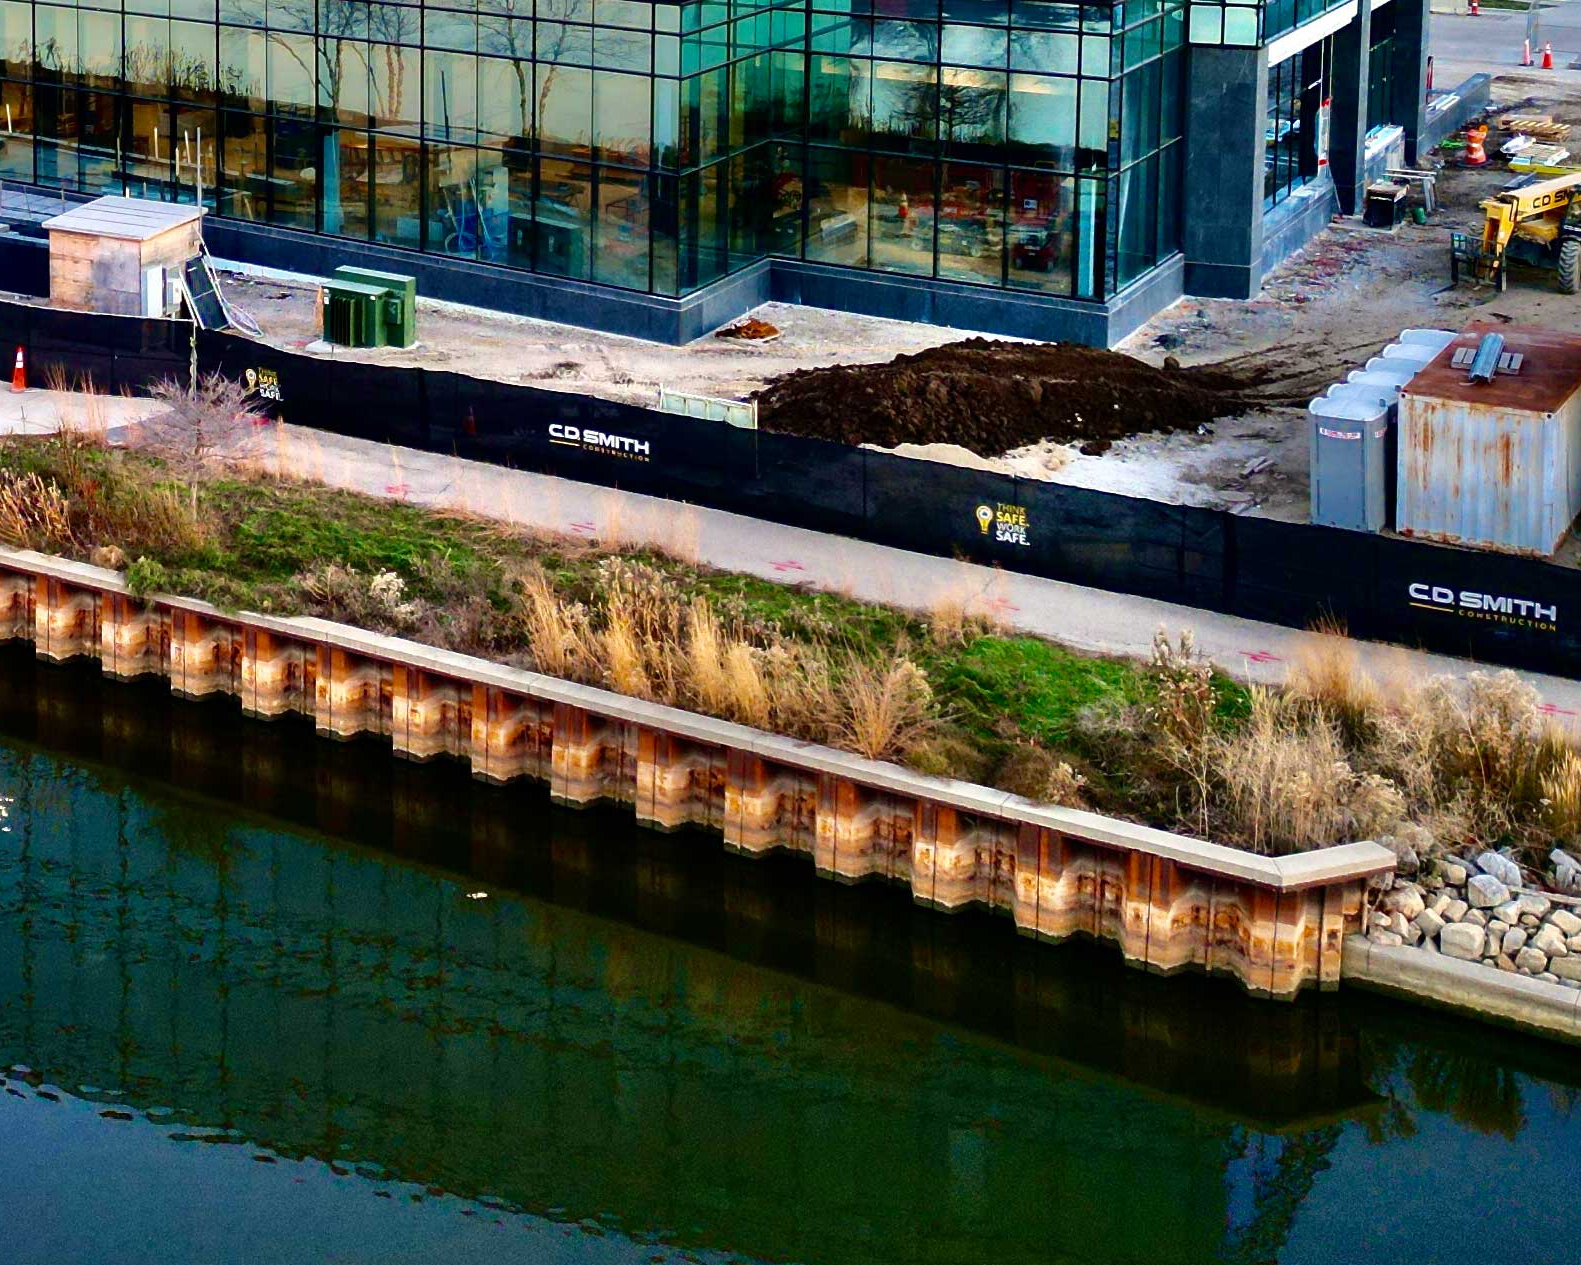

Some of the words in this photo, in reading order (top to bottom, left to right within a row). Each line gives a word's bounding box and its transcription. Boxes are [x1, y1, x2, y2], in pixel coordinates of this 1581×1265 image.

[583, 429, 650, 455] SMITH
[1459, 591, 1557, 622] SMITH
[1458, 609, 1556, 632] CONSTRUCTION
